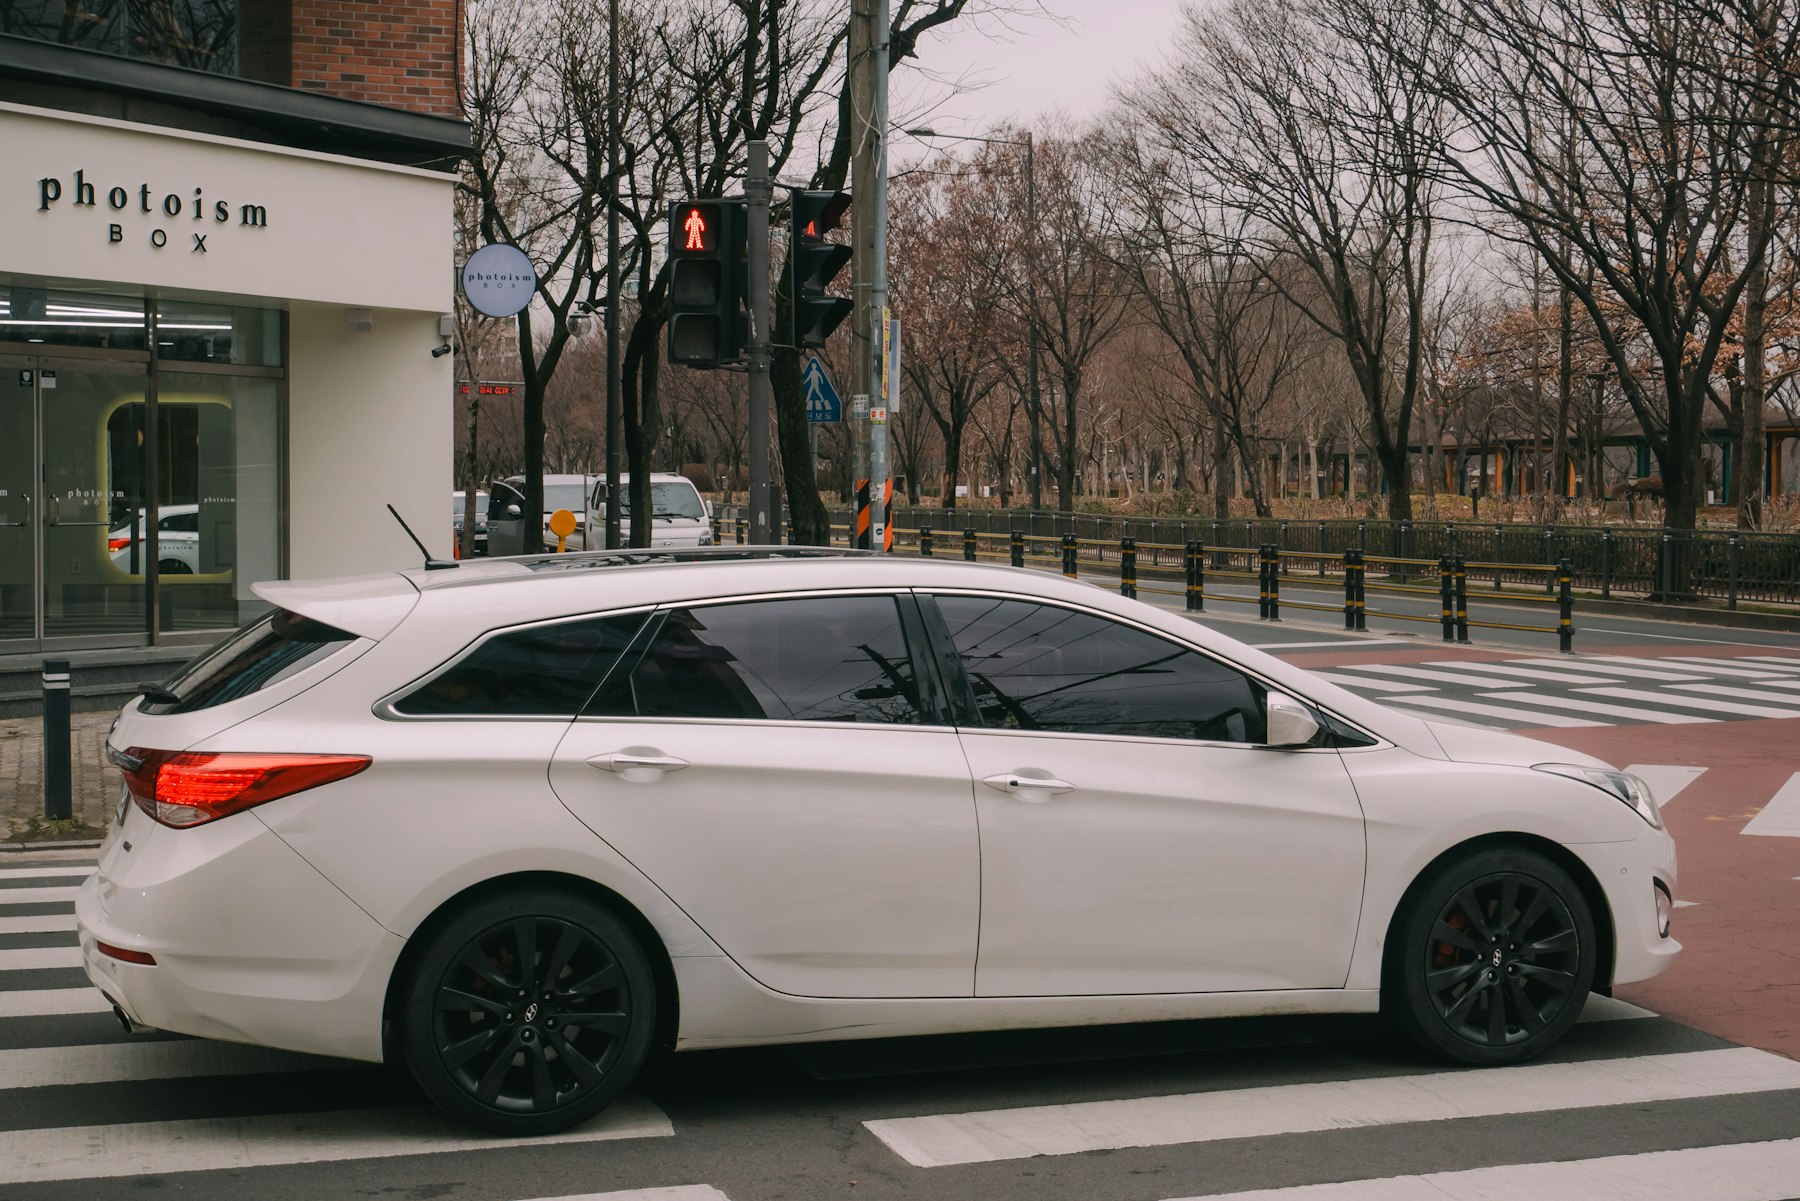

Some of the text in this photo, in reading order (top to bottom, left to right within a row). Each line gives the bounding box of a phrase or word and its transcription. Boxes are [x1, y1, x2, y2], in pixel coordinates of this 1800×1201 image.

[38, 168, 268, 227] photoism
[108, 223, 208, 252] BOX
[468, 273, 531, 282] photoism
[805, 411, 833, 421] 단보도
[203, 496, 236, 504] photoism
